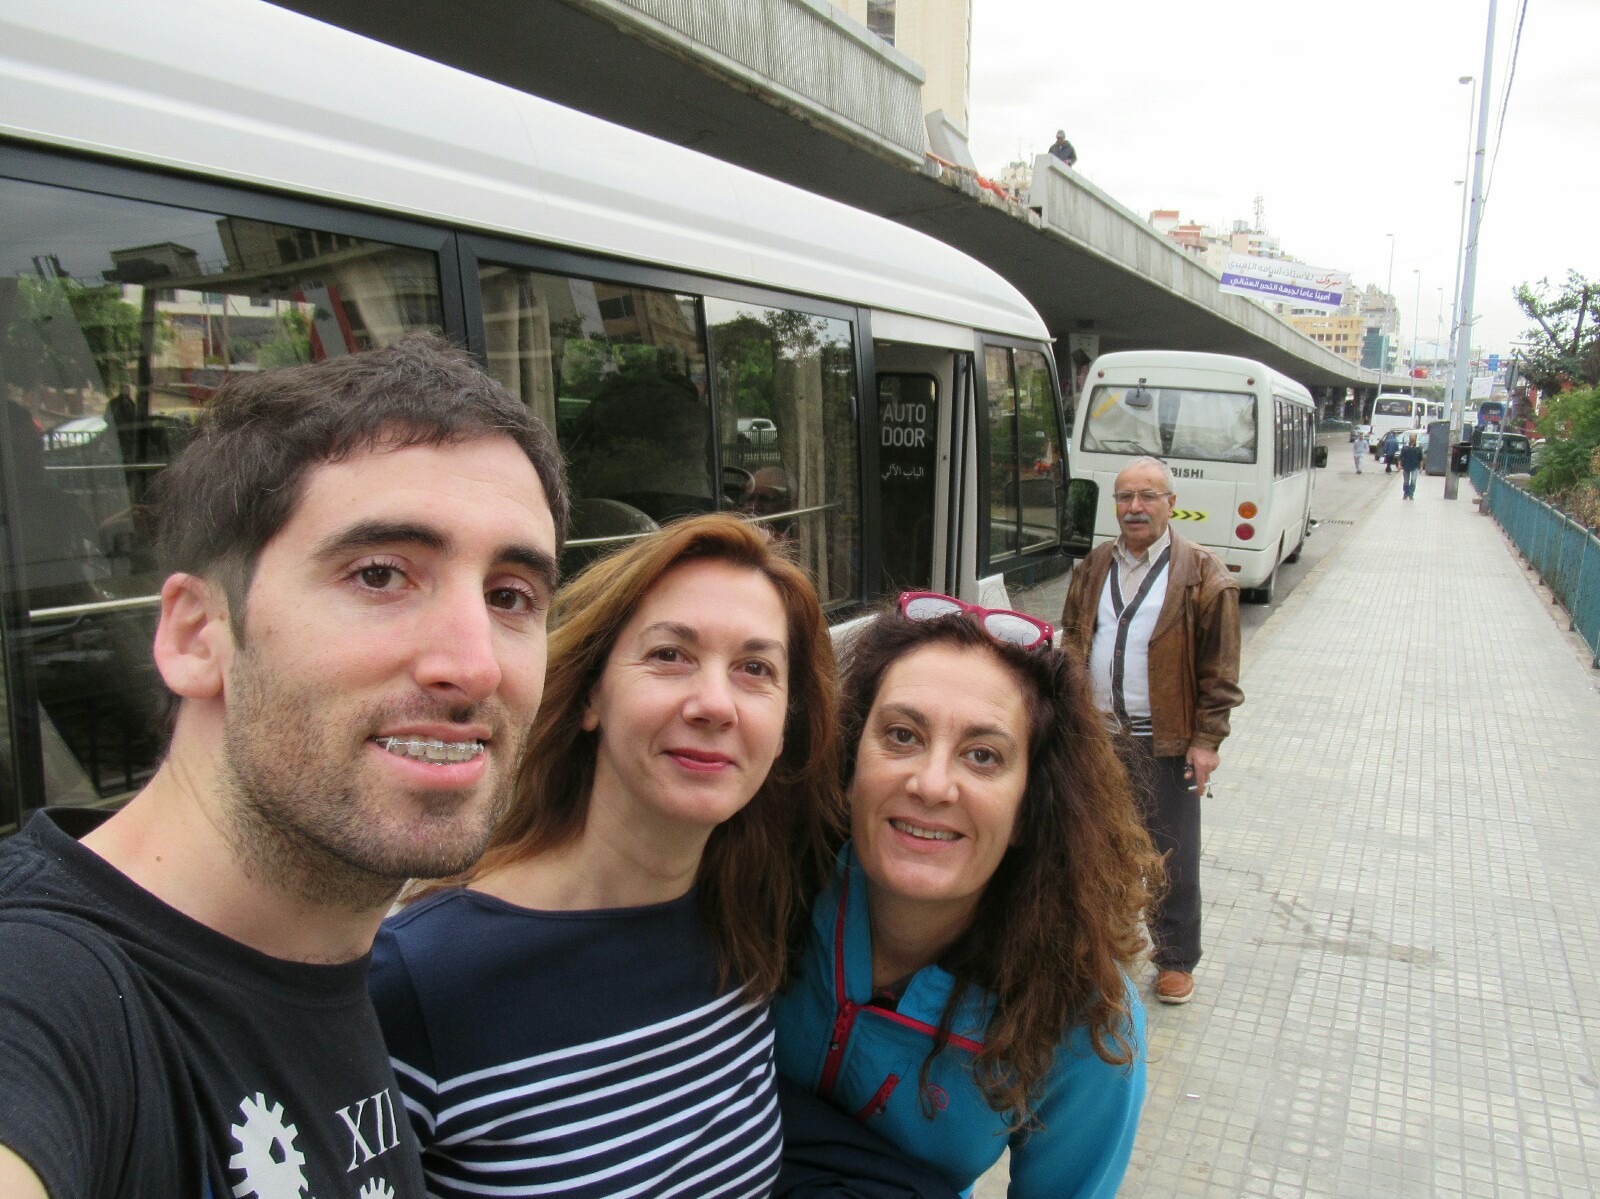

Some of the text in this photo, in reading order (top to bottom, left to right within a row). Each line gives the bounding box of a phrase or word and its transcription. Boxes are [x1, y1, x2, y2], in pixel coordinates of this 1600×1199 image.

[1316, 273, 1342, 289] مبروك
[883, 403, 926, 423] AUTO
[881, 426, 926, 448] DOOR
[903, 466, 924, 480] الباب
[335, 1087, 401, 1173] XII
